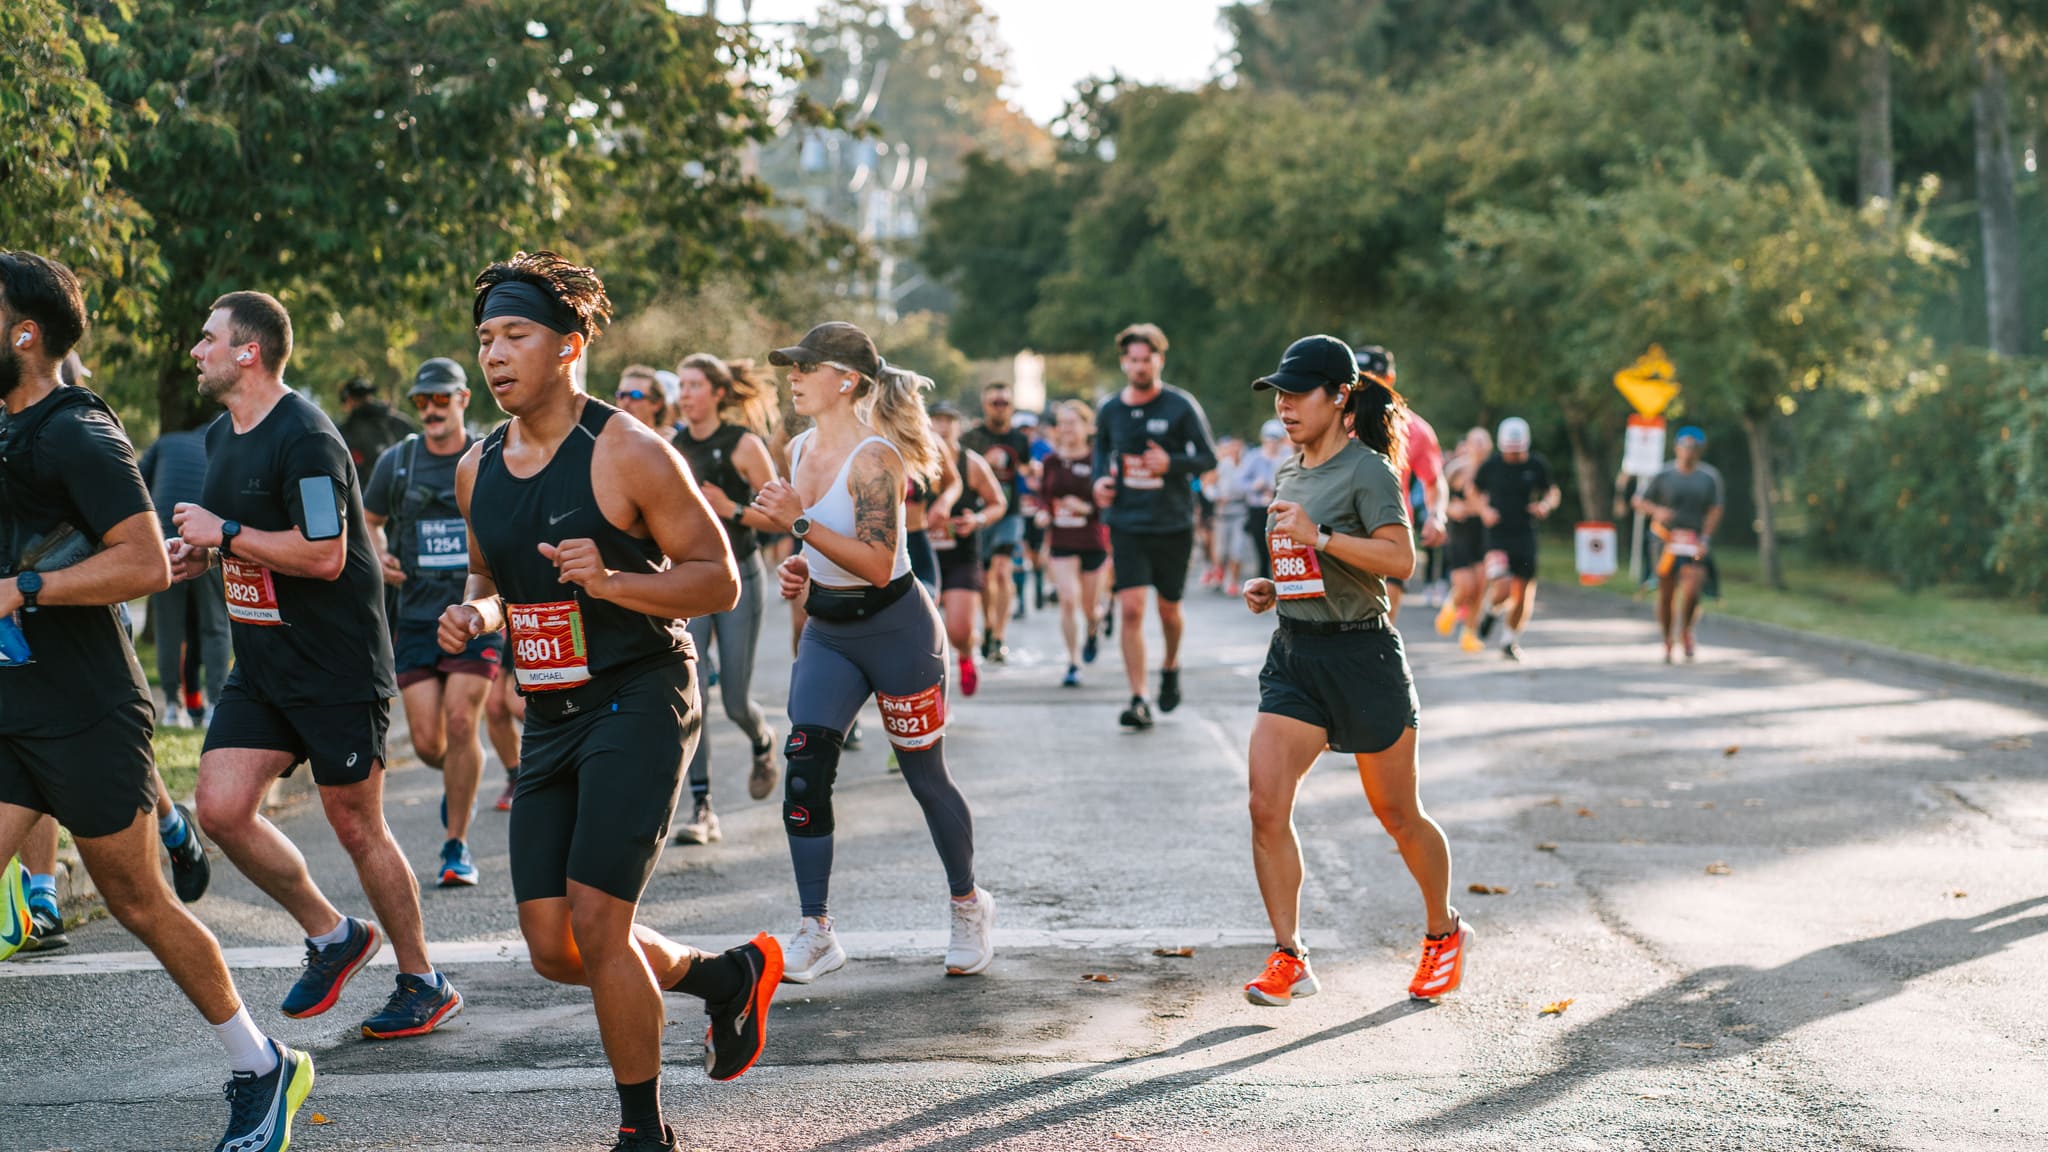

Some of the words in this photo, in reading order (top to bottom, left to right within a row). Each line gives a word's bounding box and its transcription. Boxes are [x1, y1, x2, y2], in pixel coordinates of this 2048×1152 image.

[426, 537, 461, 553] 1254
[1274, 557, 1306, 577] 3868
[226, 582, 259, 603] 3829
[517, 637, 561, 662] 4801
[529, 672, 565, 681] MICHAEL
[887, 714, 928, 733] 3921
